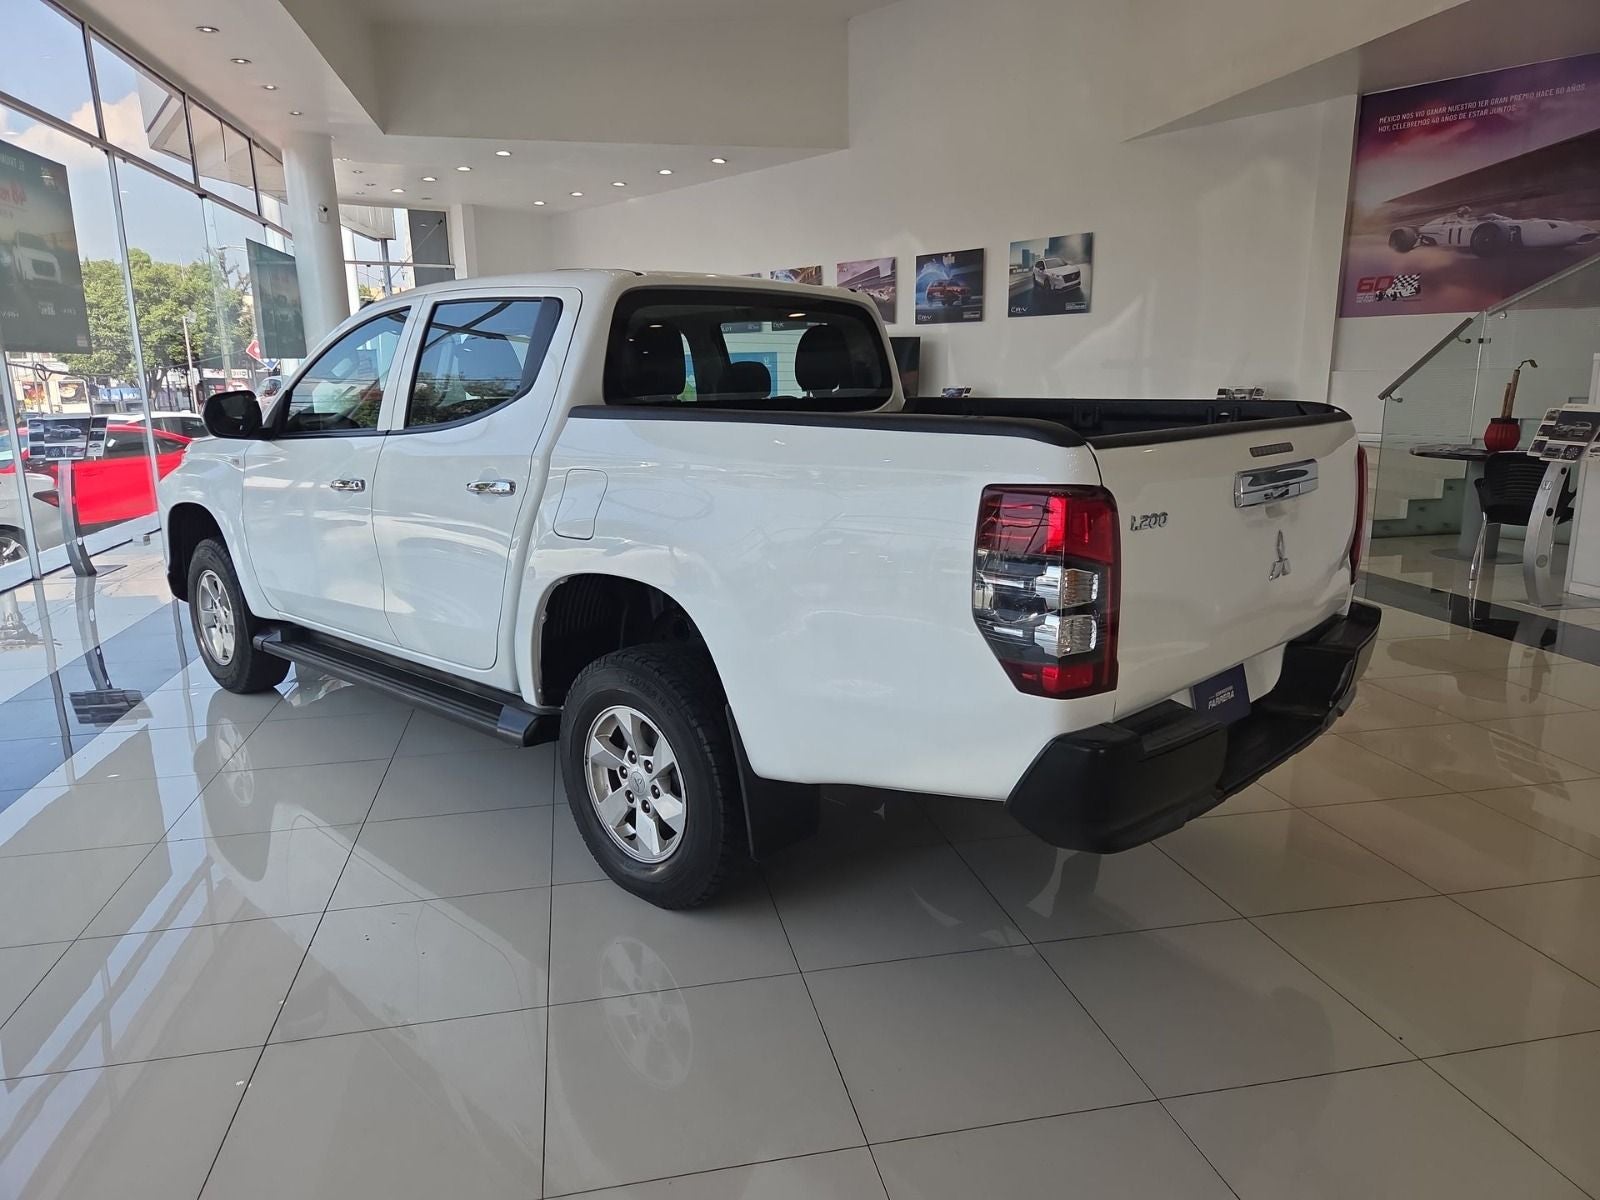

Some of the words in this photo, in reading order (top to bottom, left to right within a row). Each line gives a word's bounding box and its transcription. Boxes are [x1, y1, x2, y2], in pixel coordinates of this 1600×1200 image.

[1379, 114, 1401, 124] MÉXICO
[1401, 111, 1415, 120] NOS
[1426, 106, 1447, 116] GANAR
[1447, 101, 1477, 113] NUESTRO
[1478, 98, 1490, 108] 1ER
[1490, 95, 1509, 106] GRAN
[1509, 91, 1535, 103] PREMIO
[1535, 88, 1555, 98] HACE
[1555, 86, 1565, 95] 60
[1391, 117, 1431, 131] CELEBREMOS
[1440, 112, 1458, 123] AÑOS
[1458, 111, 1467, 120] DE
[1468, 107, 1489, 119] ESTAR
[1448, 227, 1463, 244] 11
[1357, 276, 1393, 293] 60
[1130, 511, 1169, 531] L200
